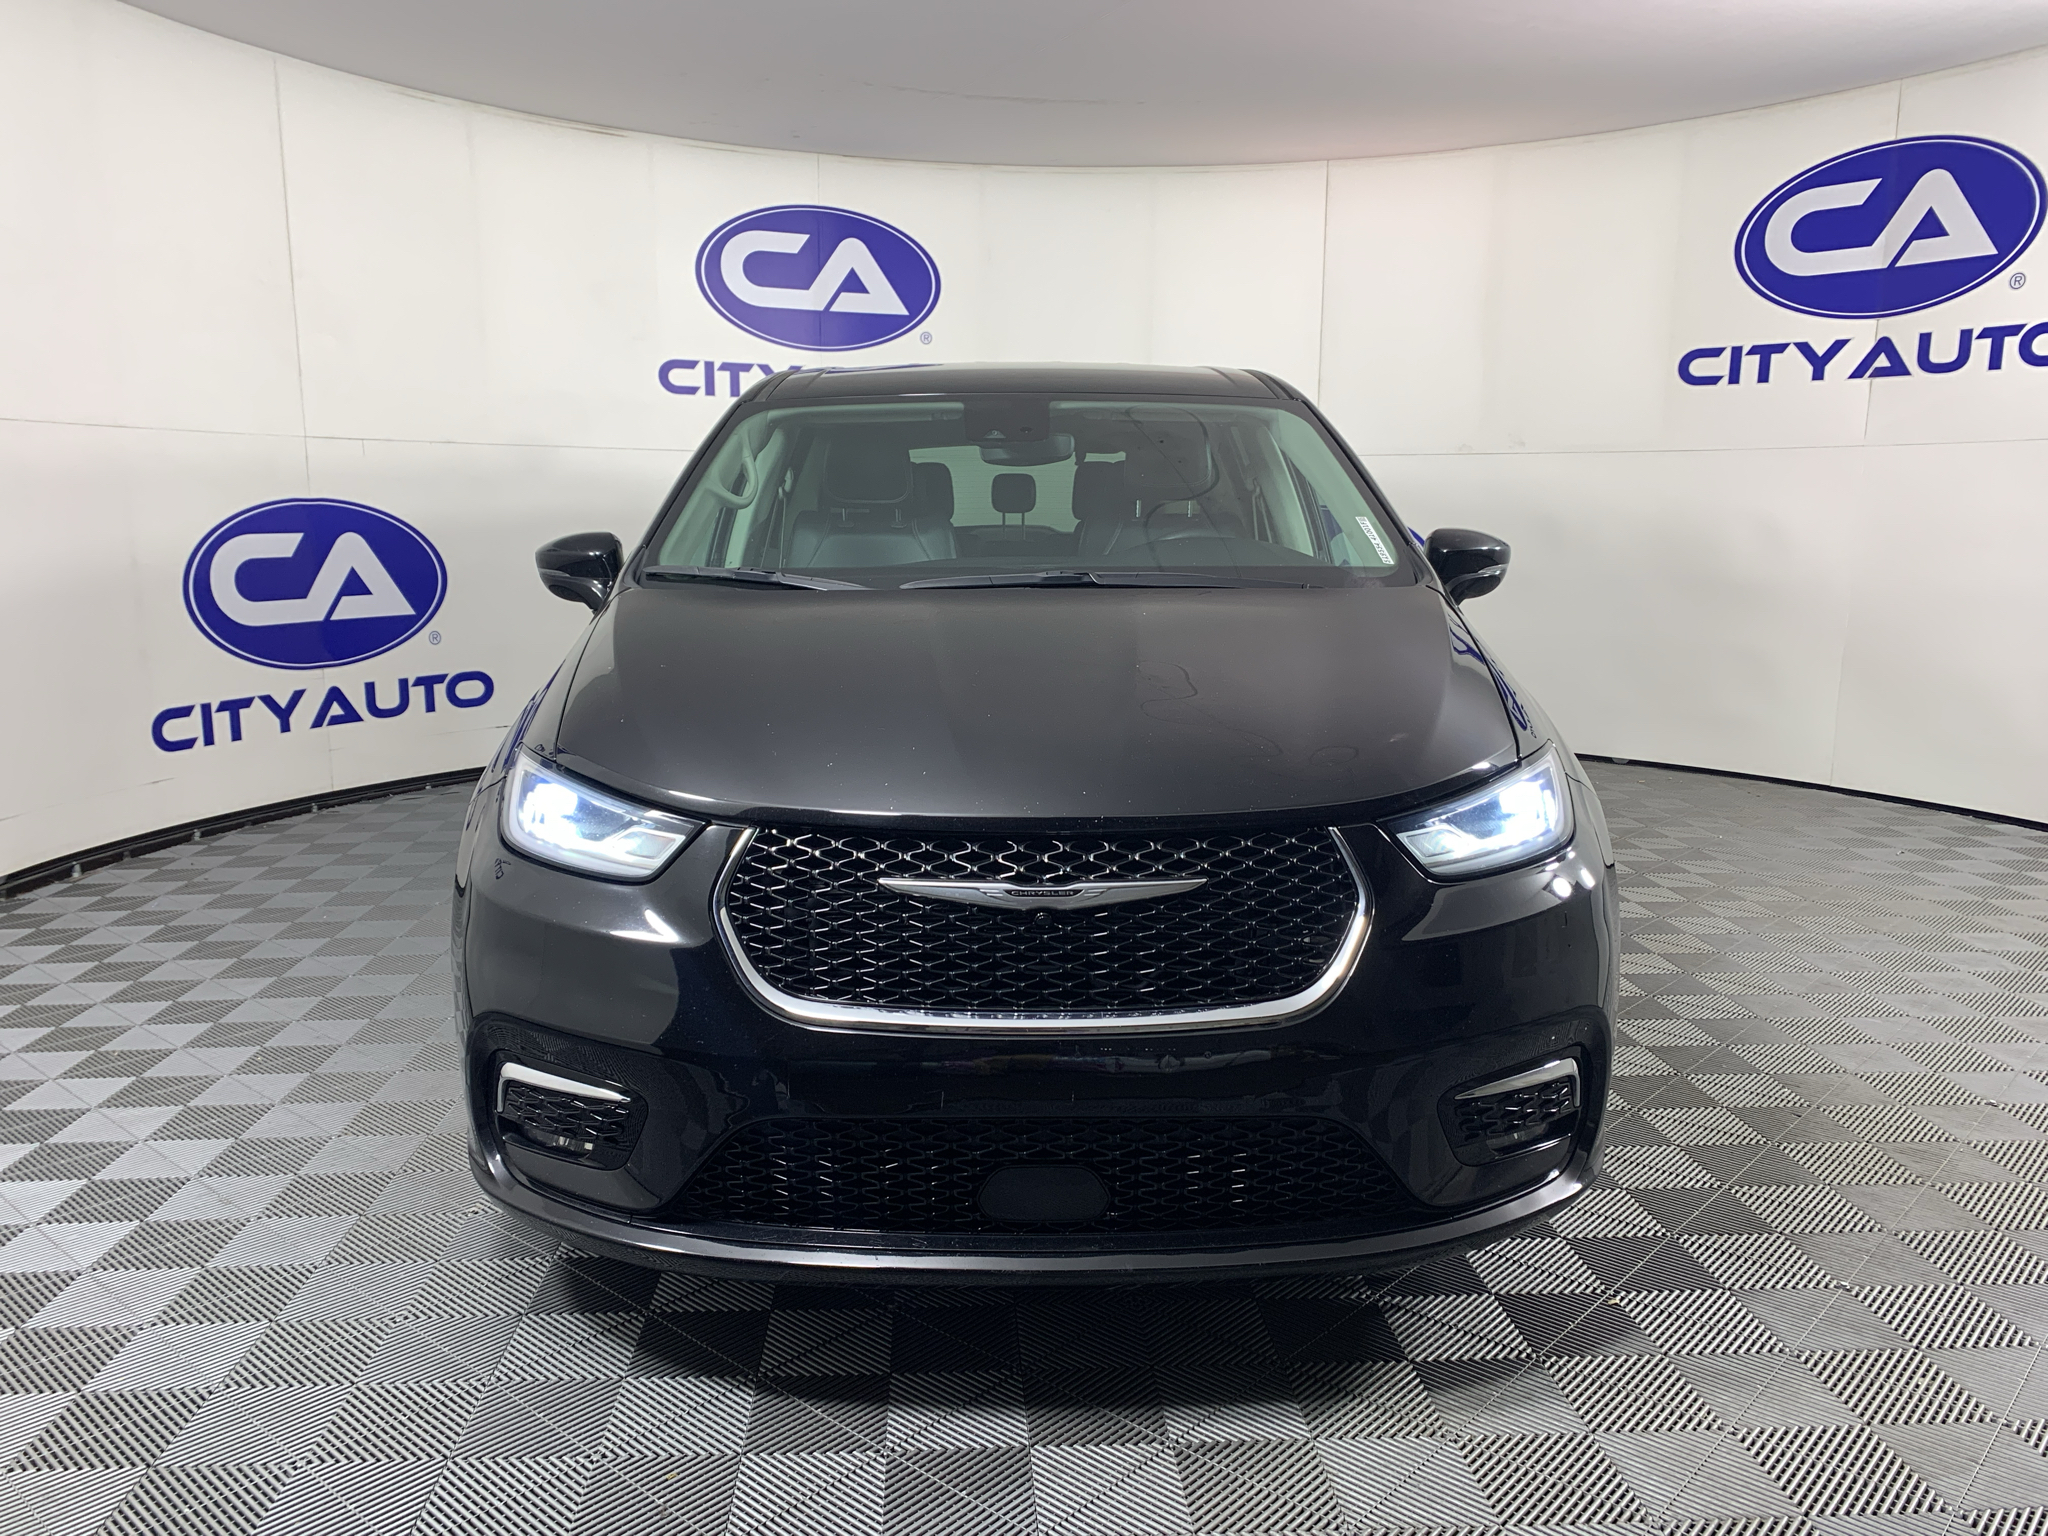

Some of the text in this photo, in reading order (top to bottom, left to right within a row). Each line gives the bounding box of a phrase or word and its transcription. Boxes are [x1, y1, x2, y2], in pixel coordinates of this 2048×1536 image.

[1764, 168, 1999, 277] CA
[720, 230, 910, 316] CA
[209, 531, 417, 627] CA
